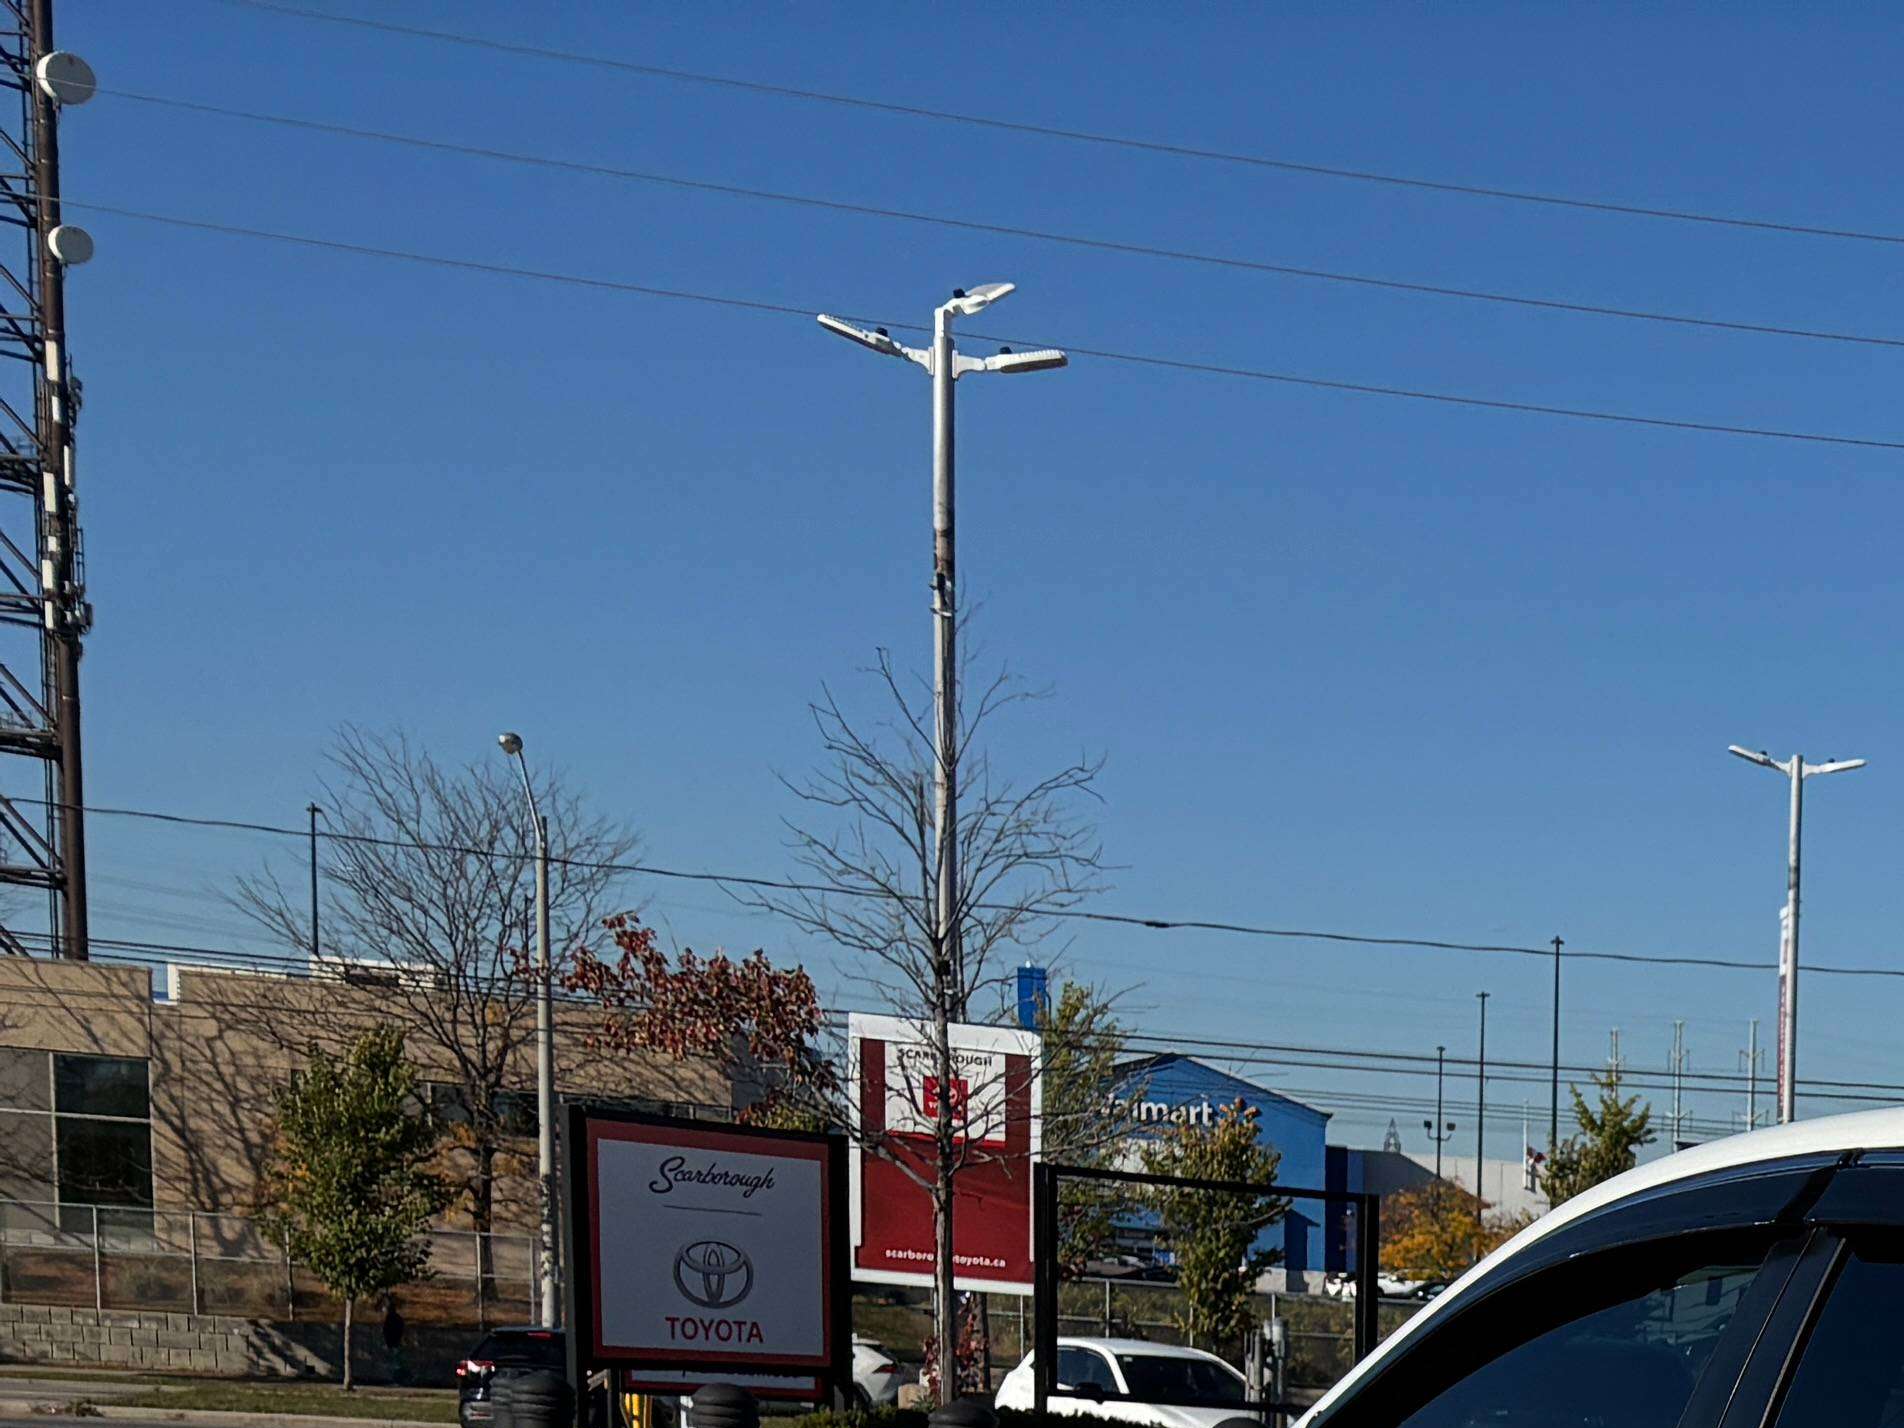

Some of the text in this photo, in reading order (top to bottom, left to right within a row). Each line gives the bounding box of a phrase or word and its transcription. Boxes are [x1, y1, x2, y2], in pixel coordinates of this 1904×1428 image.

[1092, 1092, 1213, 1127] almart
[650, 1156, 775, 1198] Scarborough
[885, 1249, 1006, 1268] scarborotoyota.ca
[665, 1316, 763, 1344] TOYOTA
